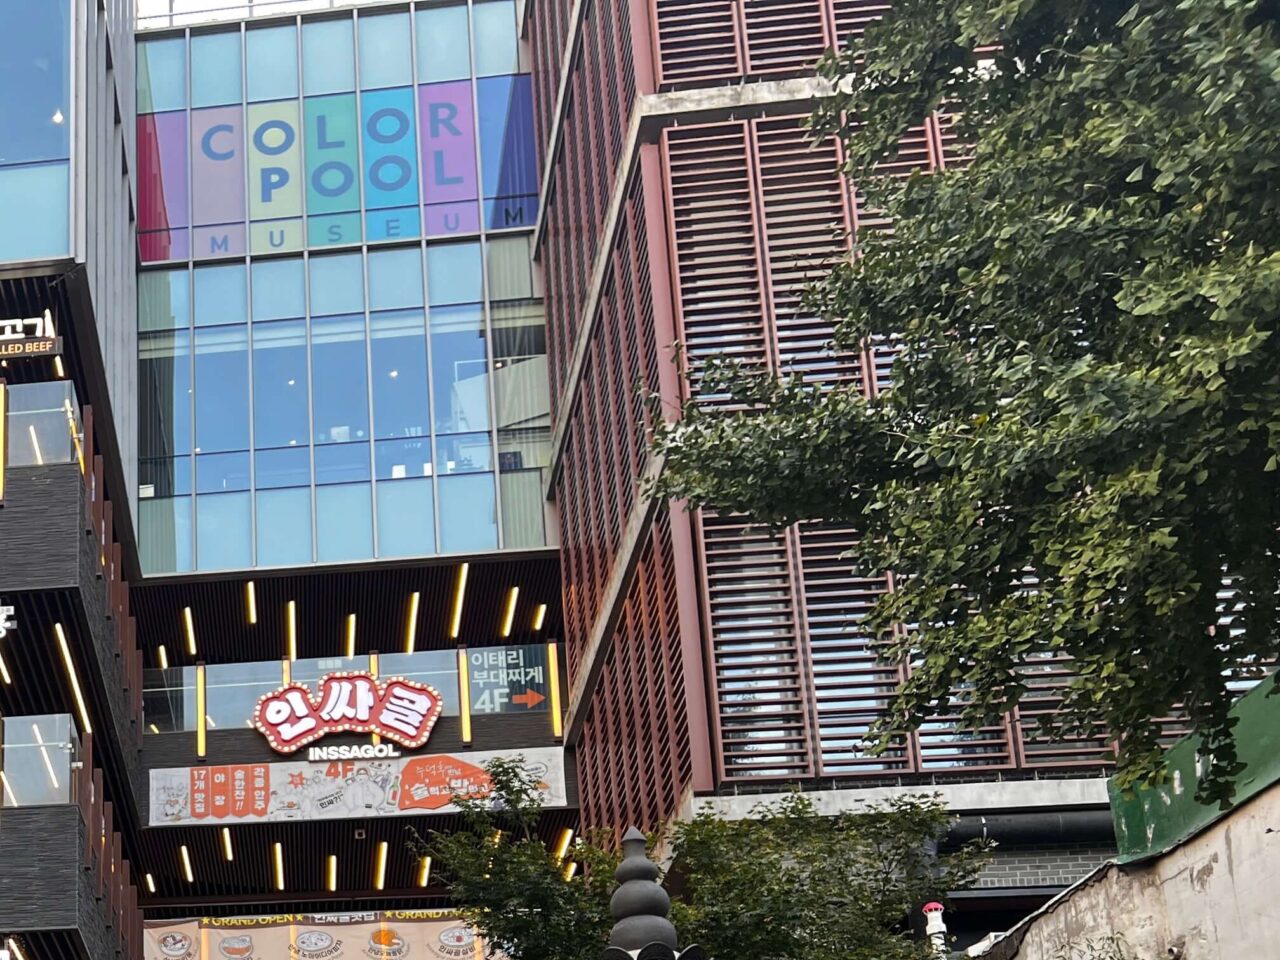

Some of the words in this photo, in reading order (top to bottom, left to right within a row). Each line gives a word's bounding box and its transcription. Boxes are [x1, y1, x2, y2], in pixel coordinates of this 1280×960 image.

[200, 102, 462, 161] COLOR
[261, 150, 464, 203] POOL
[210, 207, 524, 253] MUSEUM
[25, 341, 53, 353] BEEF
[471, 649, 524, 668] 이태리
[472, 666, 544, 687] 부대찌게
[474, 688, 509, 713] 4F
[308, 743, 400, 761] INSSAGOL
